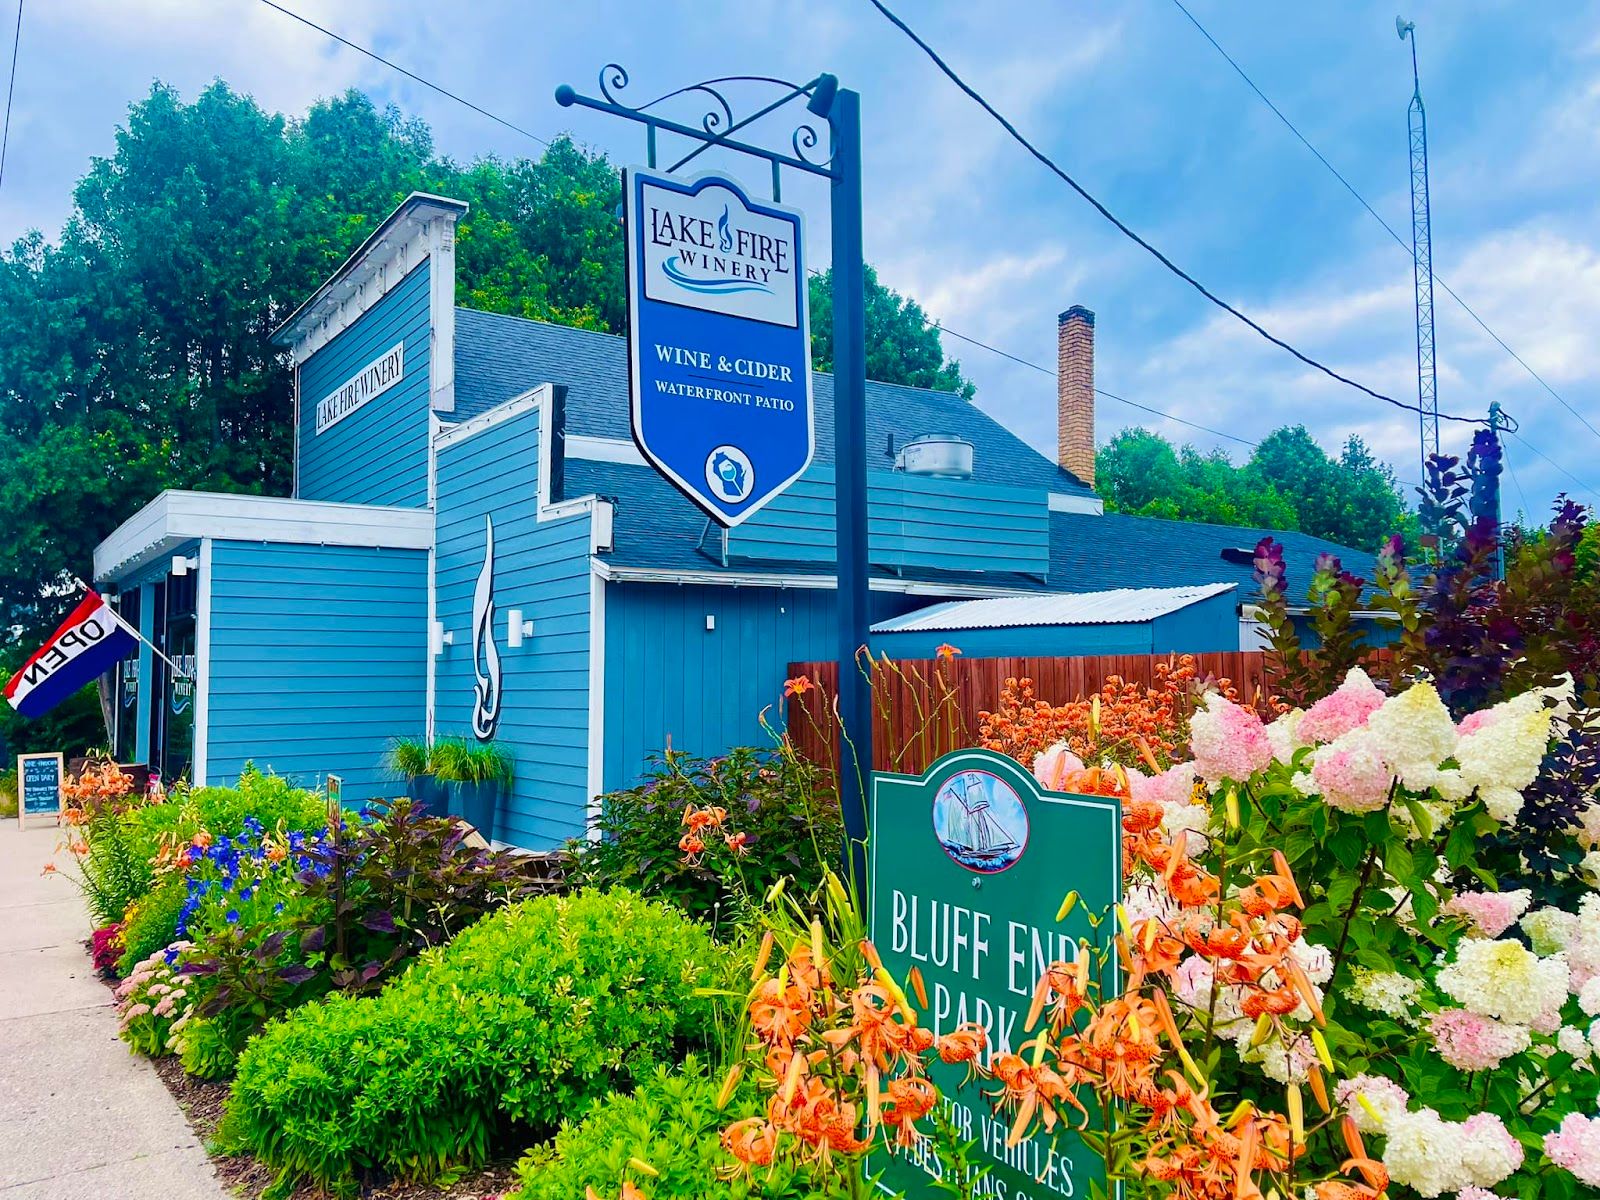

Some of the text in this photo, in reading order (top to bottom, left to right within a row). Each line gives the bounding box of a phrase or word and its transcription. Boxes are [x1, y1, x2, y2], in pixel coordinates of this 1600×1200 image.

[650, 207, 789, 274] LAKE FIRE
[678, 248, 772, 284] WINERY
[317, 347, 402, 430] LAKE FIRE WINERY
[654, 343, 793, 383] WINE & CIDER
[654, 379, 795, 412] WATERFRONT PATIO
[891, 889, 992, 980] BLUFF
[981, 1113, 1074, 1198] VEHICLES
